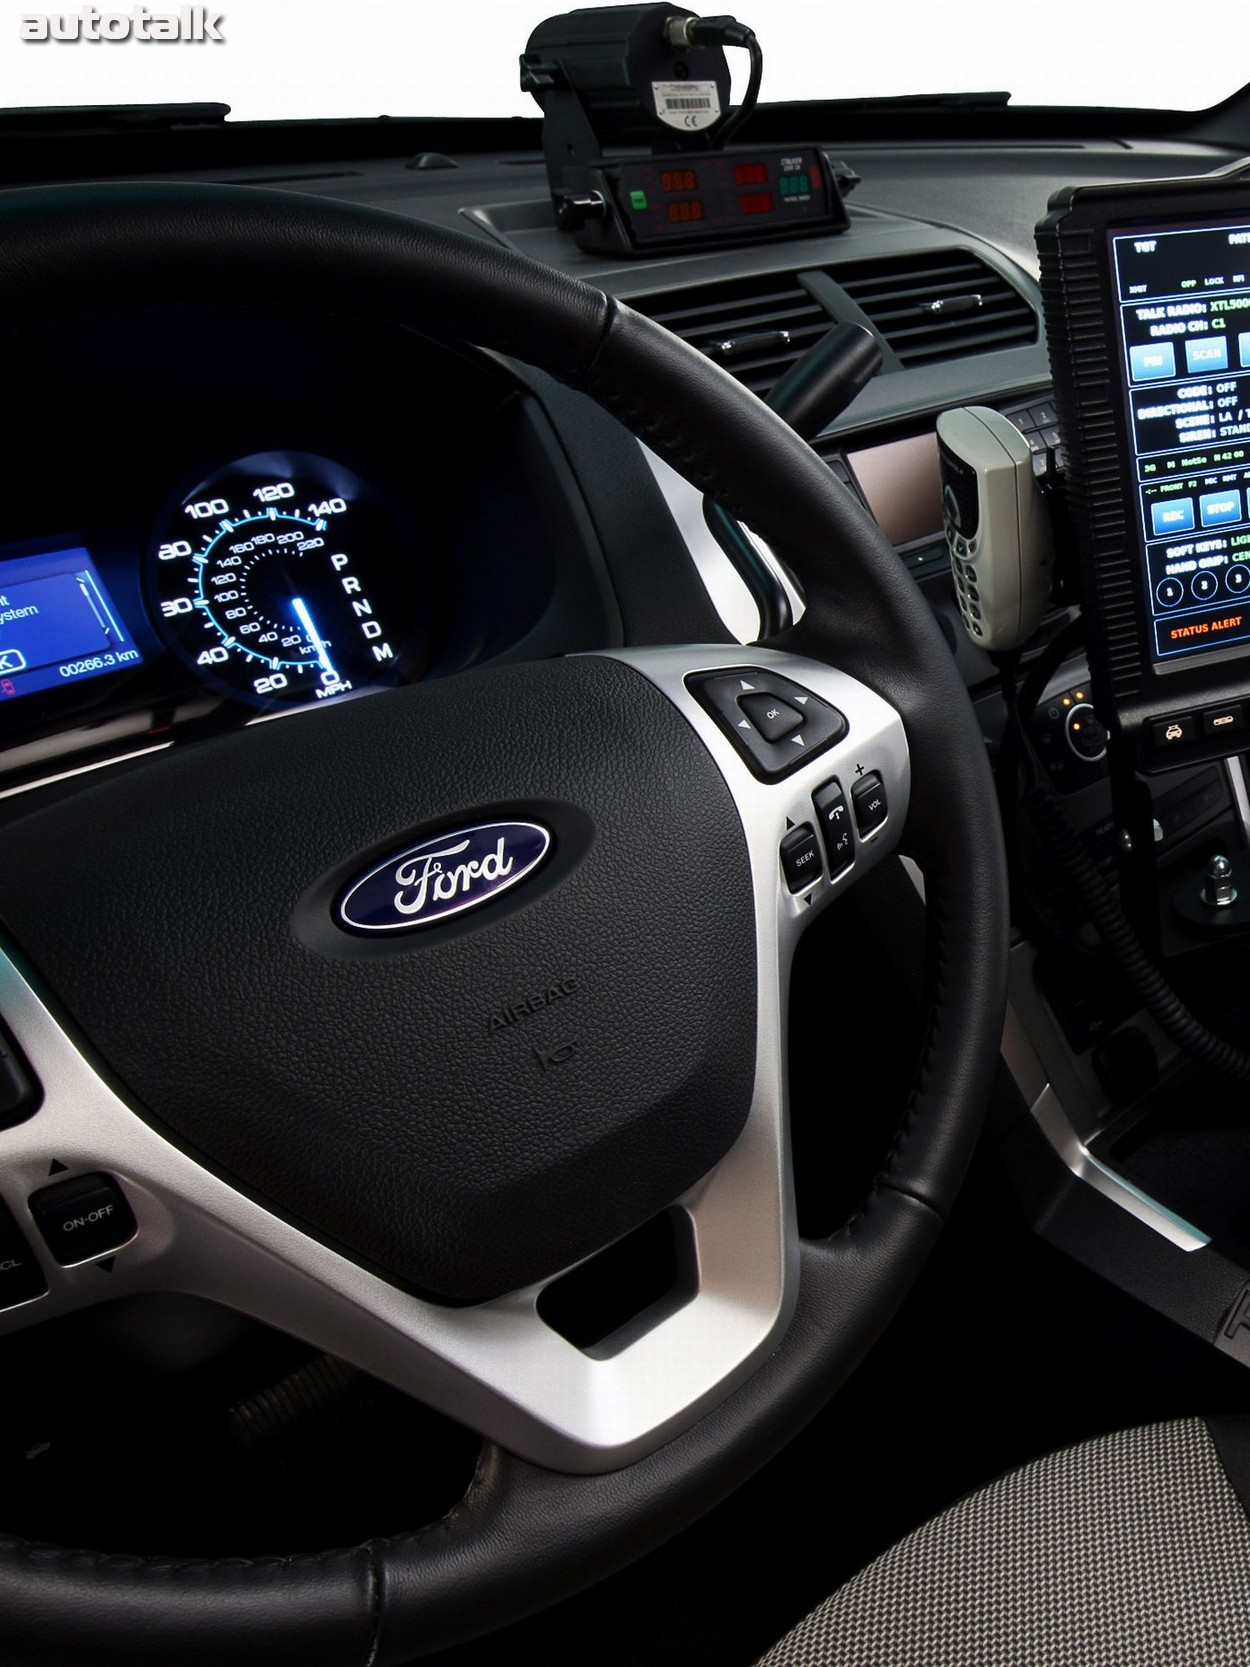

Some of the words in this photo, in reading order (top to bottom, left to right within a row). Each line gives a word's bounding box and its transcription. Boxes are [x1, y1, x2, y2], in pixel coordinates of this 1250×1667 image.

[1204, 277, 1224, 285] LOCK
[1137, 308, 1165, 320] TALK
[1168, 304, 1207, 317] RADIO:
[1151, 322, 1185, 336] RADIO
[1211, 318, 1226, 329] C1
[1216, 382, 1237, 393] OFF
[1138, 401, 1213, 420] DIRECTIONAL:
[1217, 397, 1238, 408] OFF
[1219, 412, 1233, 423] LA
[1222, 452, 1232, 460] 42
[253, 483, 295, 502] 120
[184, 499, 229, 519] 100
[308, 498, 347, 517] 140
[276, 531, 304, 544] 200
[297, 537, 324, 551] 220
[216, 556, 242, 569] 140
[330, 554, 348, 572] P
[211, 573, 237, 586] 120
[342, 577, 361, 595] R
[214, 590, 239, 603] 100
[225, 607, 247, 620] 80
[352, 598, 372, 617] N
[239, 622, 260, 634] 60
[362, 621, 382, 639] D
[1171, 624, 1209, 639] STATUS
[1212, 616, 1242, 631] ALERT
[258, 632, 278, 643] 40
[281, 634, 302, 647] 20
[197, 647, 229, 665] 40
[372, 643, 393, 662] M
[60, 654, 115, 677] 00266.3
[116, 649, 138, 662] km
[253, 674, 288, 694] 20
[320, 670, 340, 686] 0
[315, 680, 352, 698] MPH
[767, 709, 780, 719] OK
[869, 799, 881, 810] VOL
[796, 850, 814, 867] SEEK
[394, 837, 513, 914] Ford
[489, 977, 581, 1033] AIRBAG
[63, 1205, 114, 1231] ON-OFF
